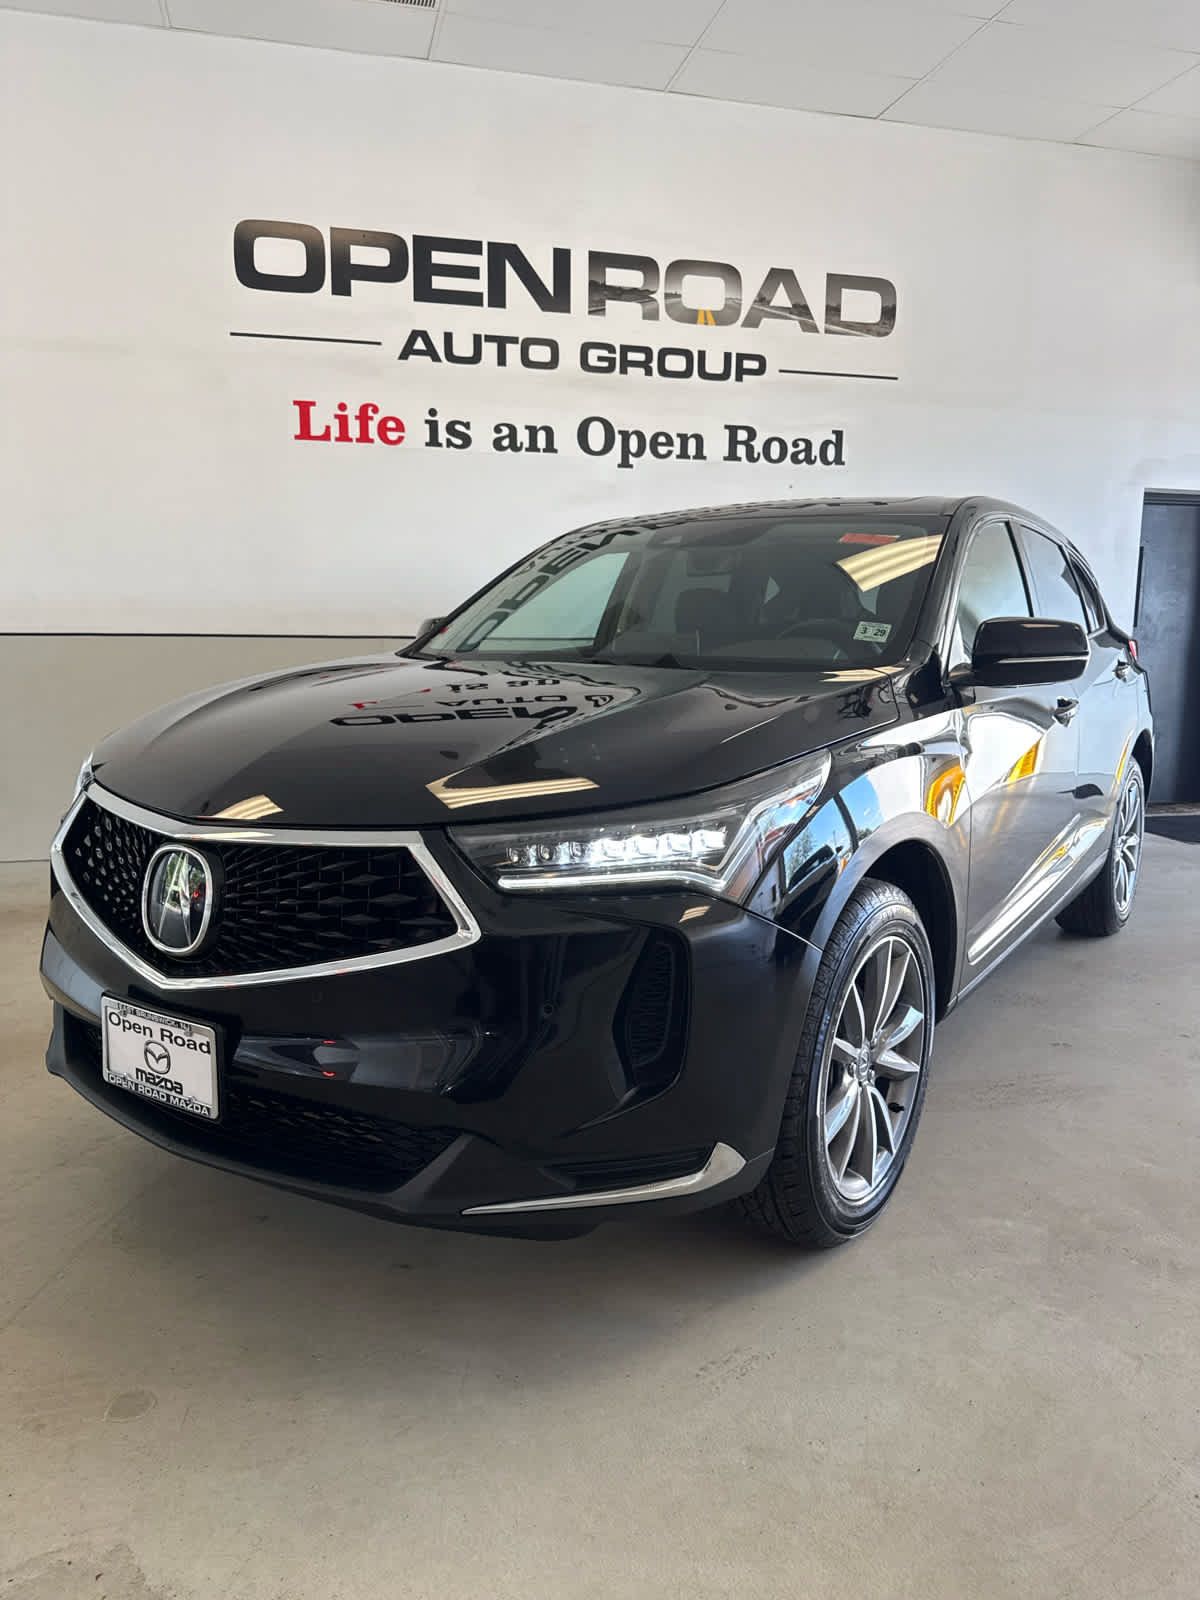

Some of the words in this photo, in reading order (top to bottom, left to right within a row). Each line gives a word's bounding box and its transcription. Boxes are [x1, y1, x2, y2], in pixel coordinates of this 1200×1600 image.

[233, 219, 571, 314] OPEN
[588, 250, 897, 338] ROAD
[397, 329, 559, 370] AUTO
[580, 341, 767, 382] GROUP
[293, 400, 405, 446] Life
[425, 408, 472, 449] is
[492, 421, 558, 454] an
[577, 416, 707, 469] Open
[723, 424, 845, 466] Road
[109, 1011, 153, 1038] Open
[160, 1028, 211, 1055] Road
[109, 1074, 136, 1091] OPEN
[138, 1085, 167, 1101] ROAD
[170, 1095, 210, 1115] MAZDA
